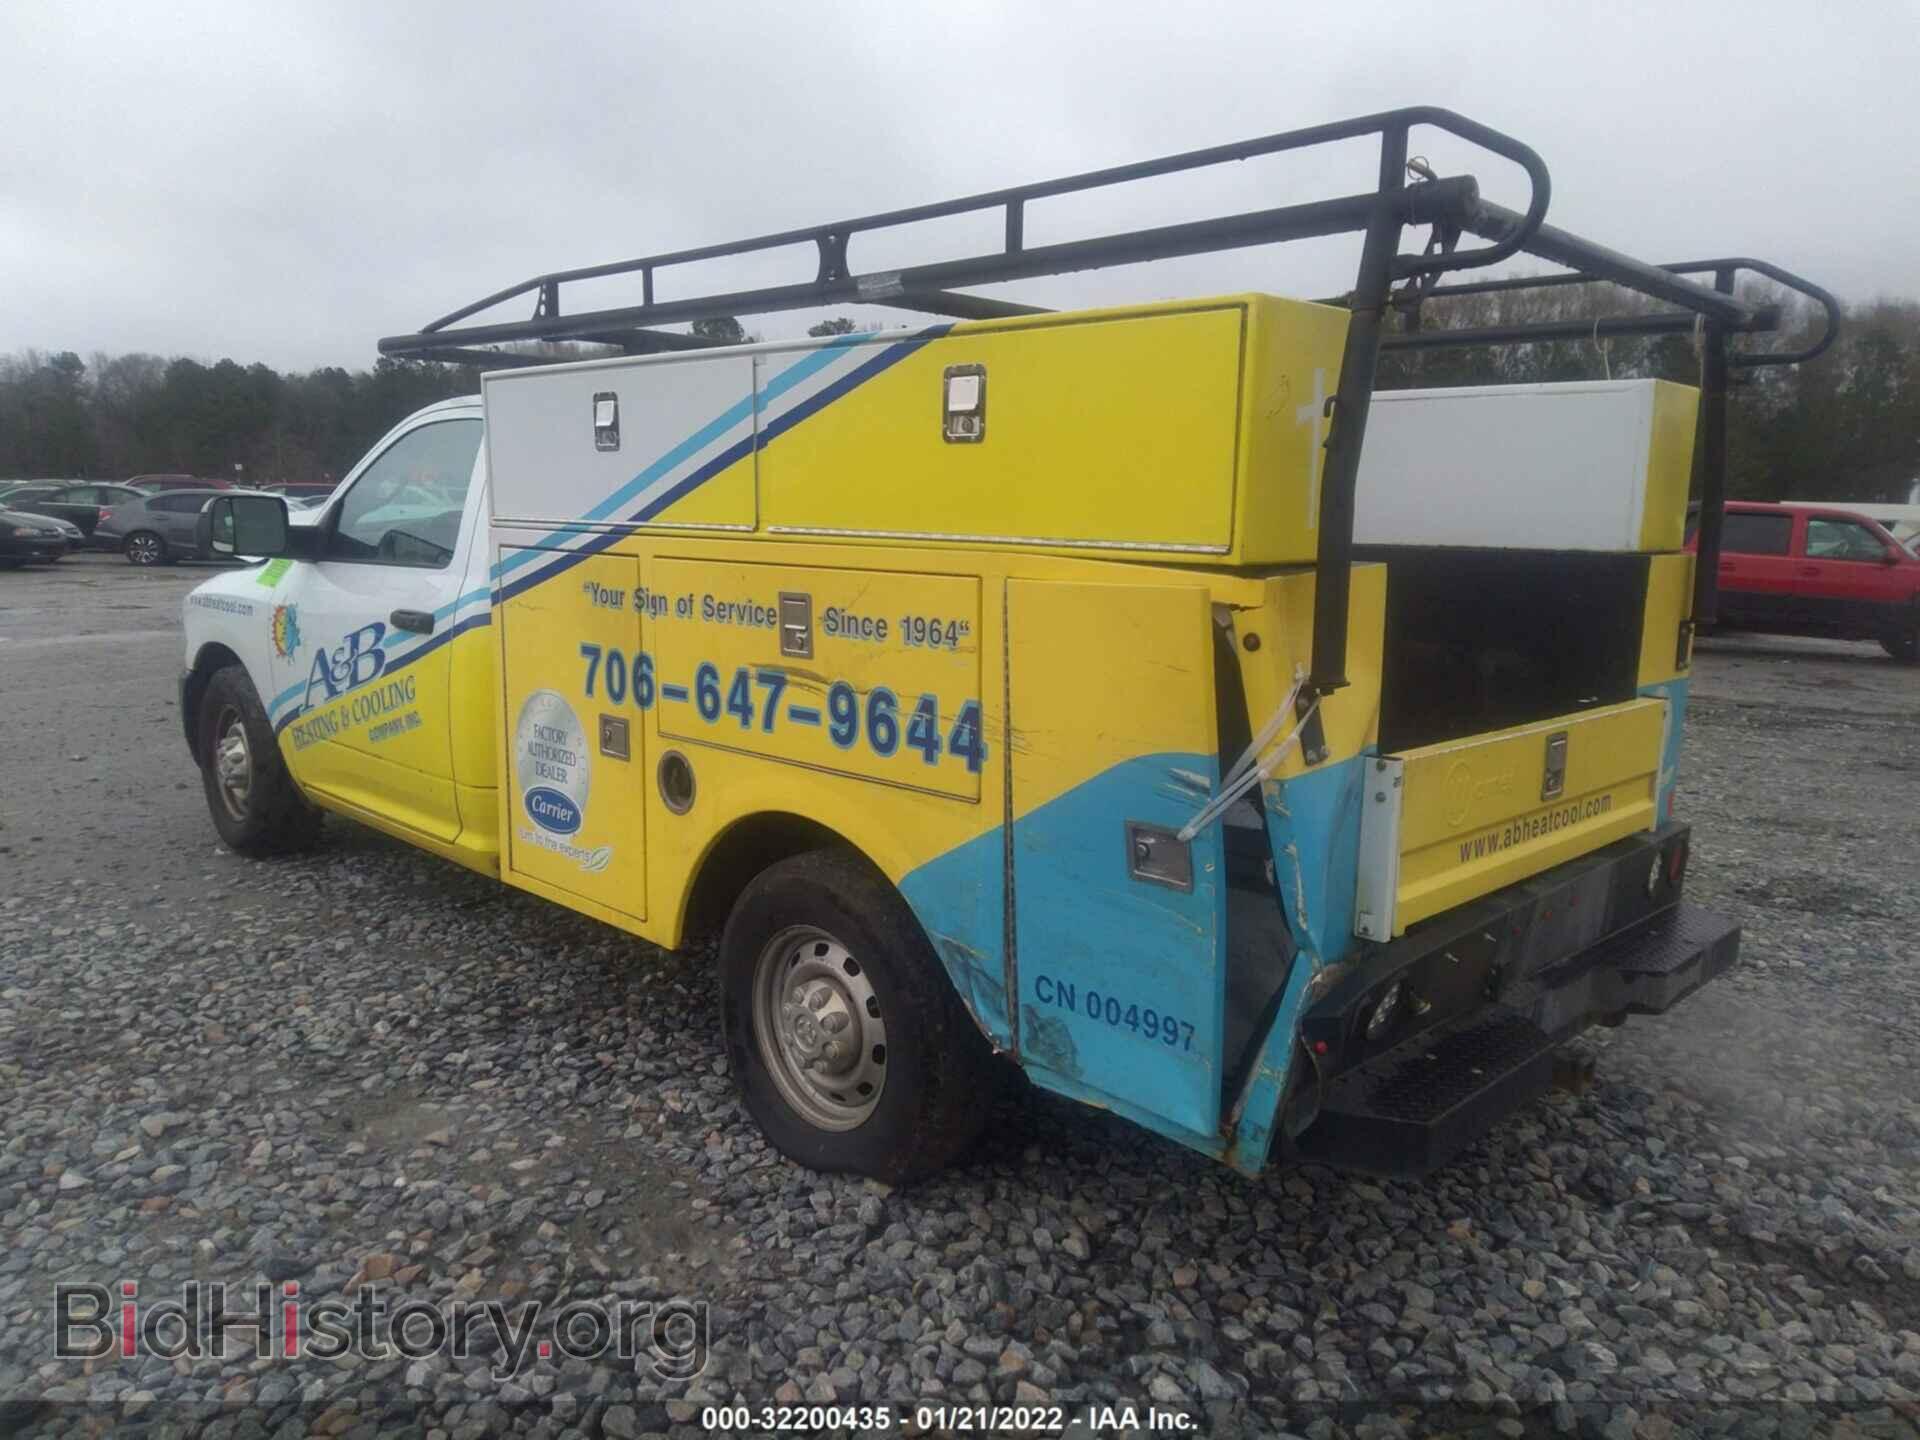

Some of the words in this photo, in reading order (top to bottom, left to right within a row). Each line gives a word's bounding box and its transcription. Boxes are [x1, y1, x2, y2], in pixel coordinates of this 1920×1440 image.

[634, 587, 668, 621] Sign
[678, 593, 694, 618] of
[703, 593, 779, 629] Service
[825, 606, 890, 642] Since
[300, 621, 386, 713] A&B
[352, 674, 416, 723] COOLING
[580, 641, 989, 775] 706-647-9644
[528, 740, 577, 767] AUTHORIZED
[533, 723, 568, 746] FACTORY
[535, 761, 569, 785] DEALER
[531, 795, 574, 823] Carrier
[1459, 793, 1612, 862] www.abheatcool.com
[1035, 975, 1076, 1012] CN
[1086, 991, 1195, 1051] 004997
